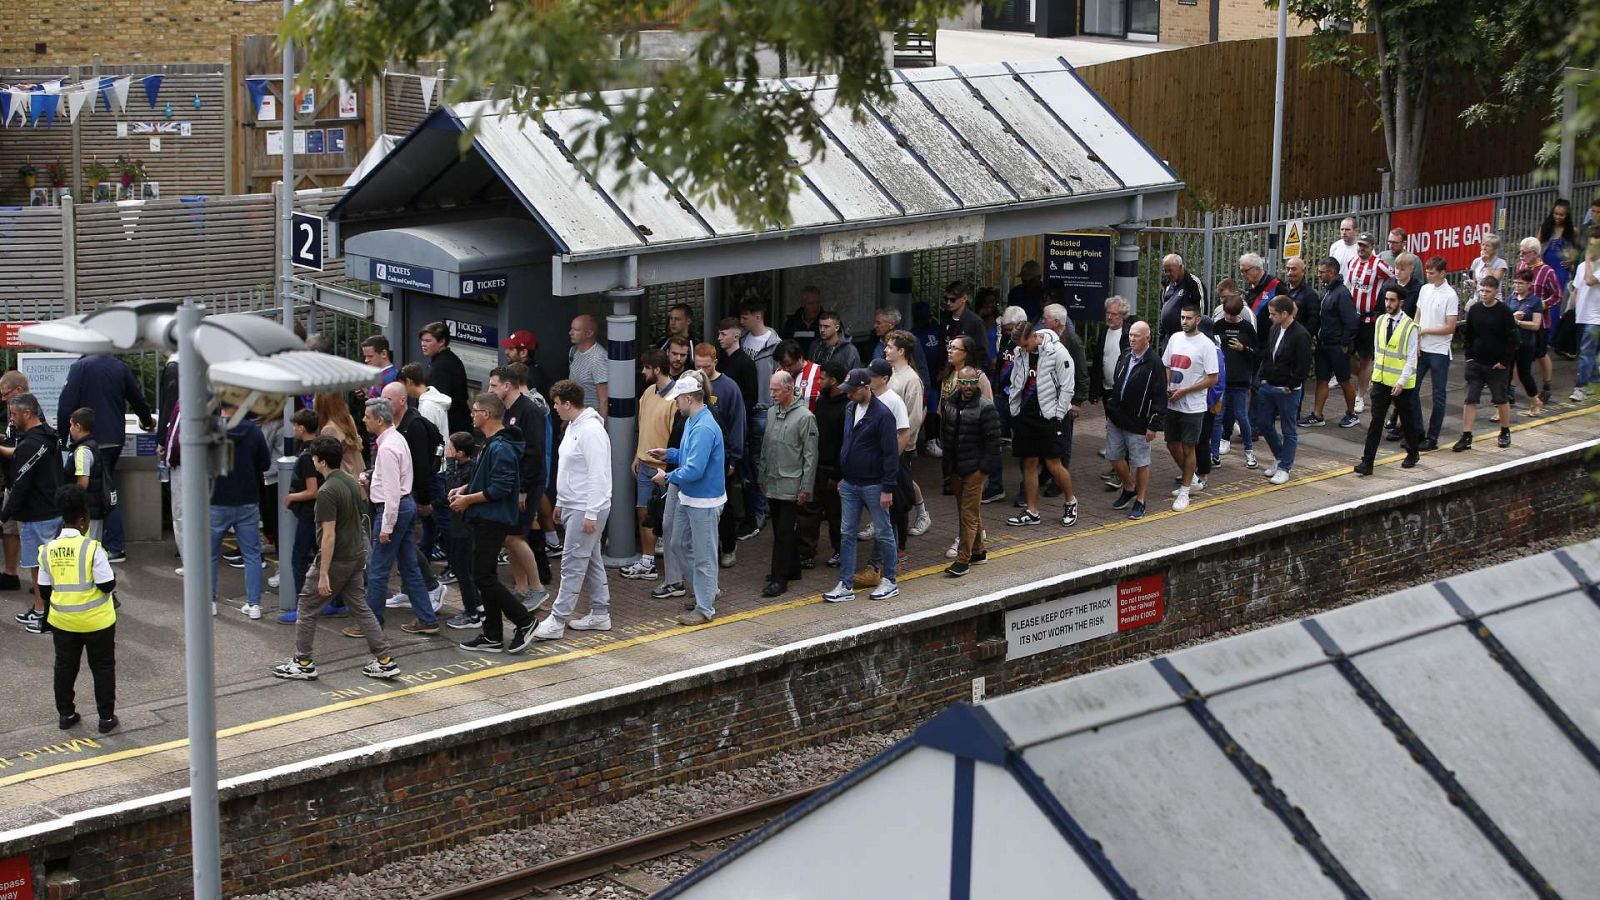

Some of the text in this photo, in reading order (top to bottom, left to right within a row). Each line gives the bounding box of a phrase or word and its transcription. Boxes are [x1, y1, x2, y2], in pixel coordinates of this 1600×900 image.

[300, 223, 314, 260] 2
[1050, 239, 1080, 247] Assisted
[1407, 231, 1431, 254] IND
[1434, 227, 1460, 250] THE
[1050, 248, 1102, 258] Boarding Point
[388, 265, 411, 276] TICKETS
[412, 280, 431, 289] Payments
[477, 279, 505, 289] TICKETS
[457, 321, 482, 333] TICKETS
[466, 334, 487, 343] Payments
[1120, 585, 1142, 596] Warning
[1128, 596, 1137, 604] not
[1137, 592, 1160, 603] trespass
[1128, 604, 1137, 612] the
[1137, 600, 1156, 611] railway
[1011, 598, 1112, 631] PLEASE KEEP OFF THE TRACK
[1120, 610, 1157, 624] Penalty £1000
[1019, 616, 1105, 645] ITS NOT WORTH THE RISK
[399, 656, 500, 684] YELLOW
[320, 680, 393, 701] LINE
[0, 877, 25, 891] spass
